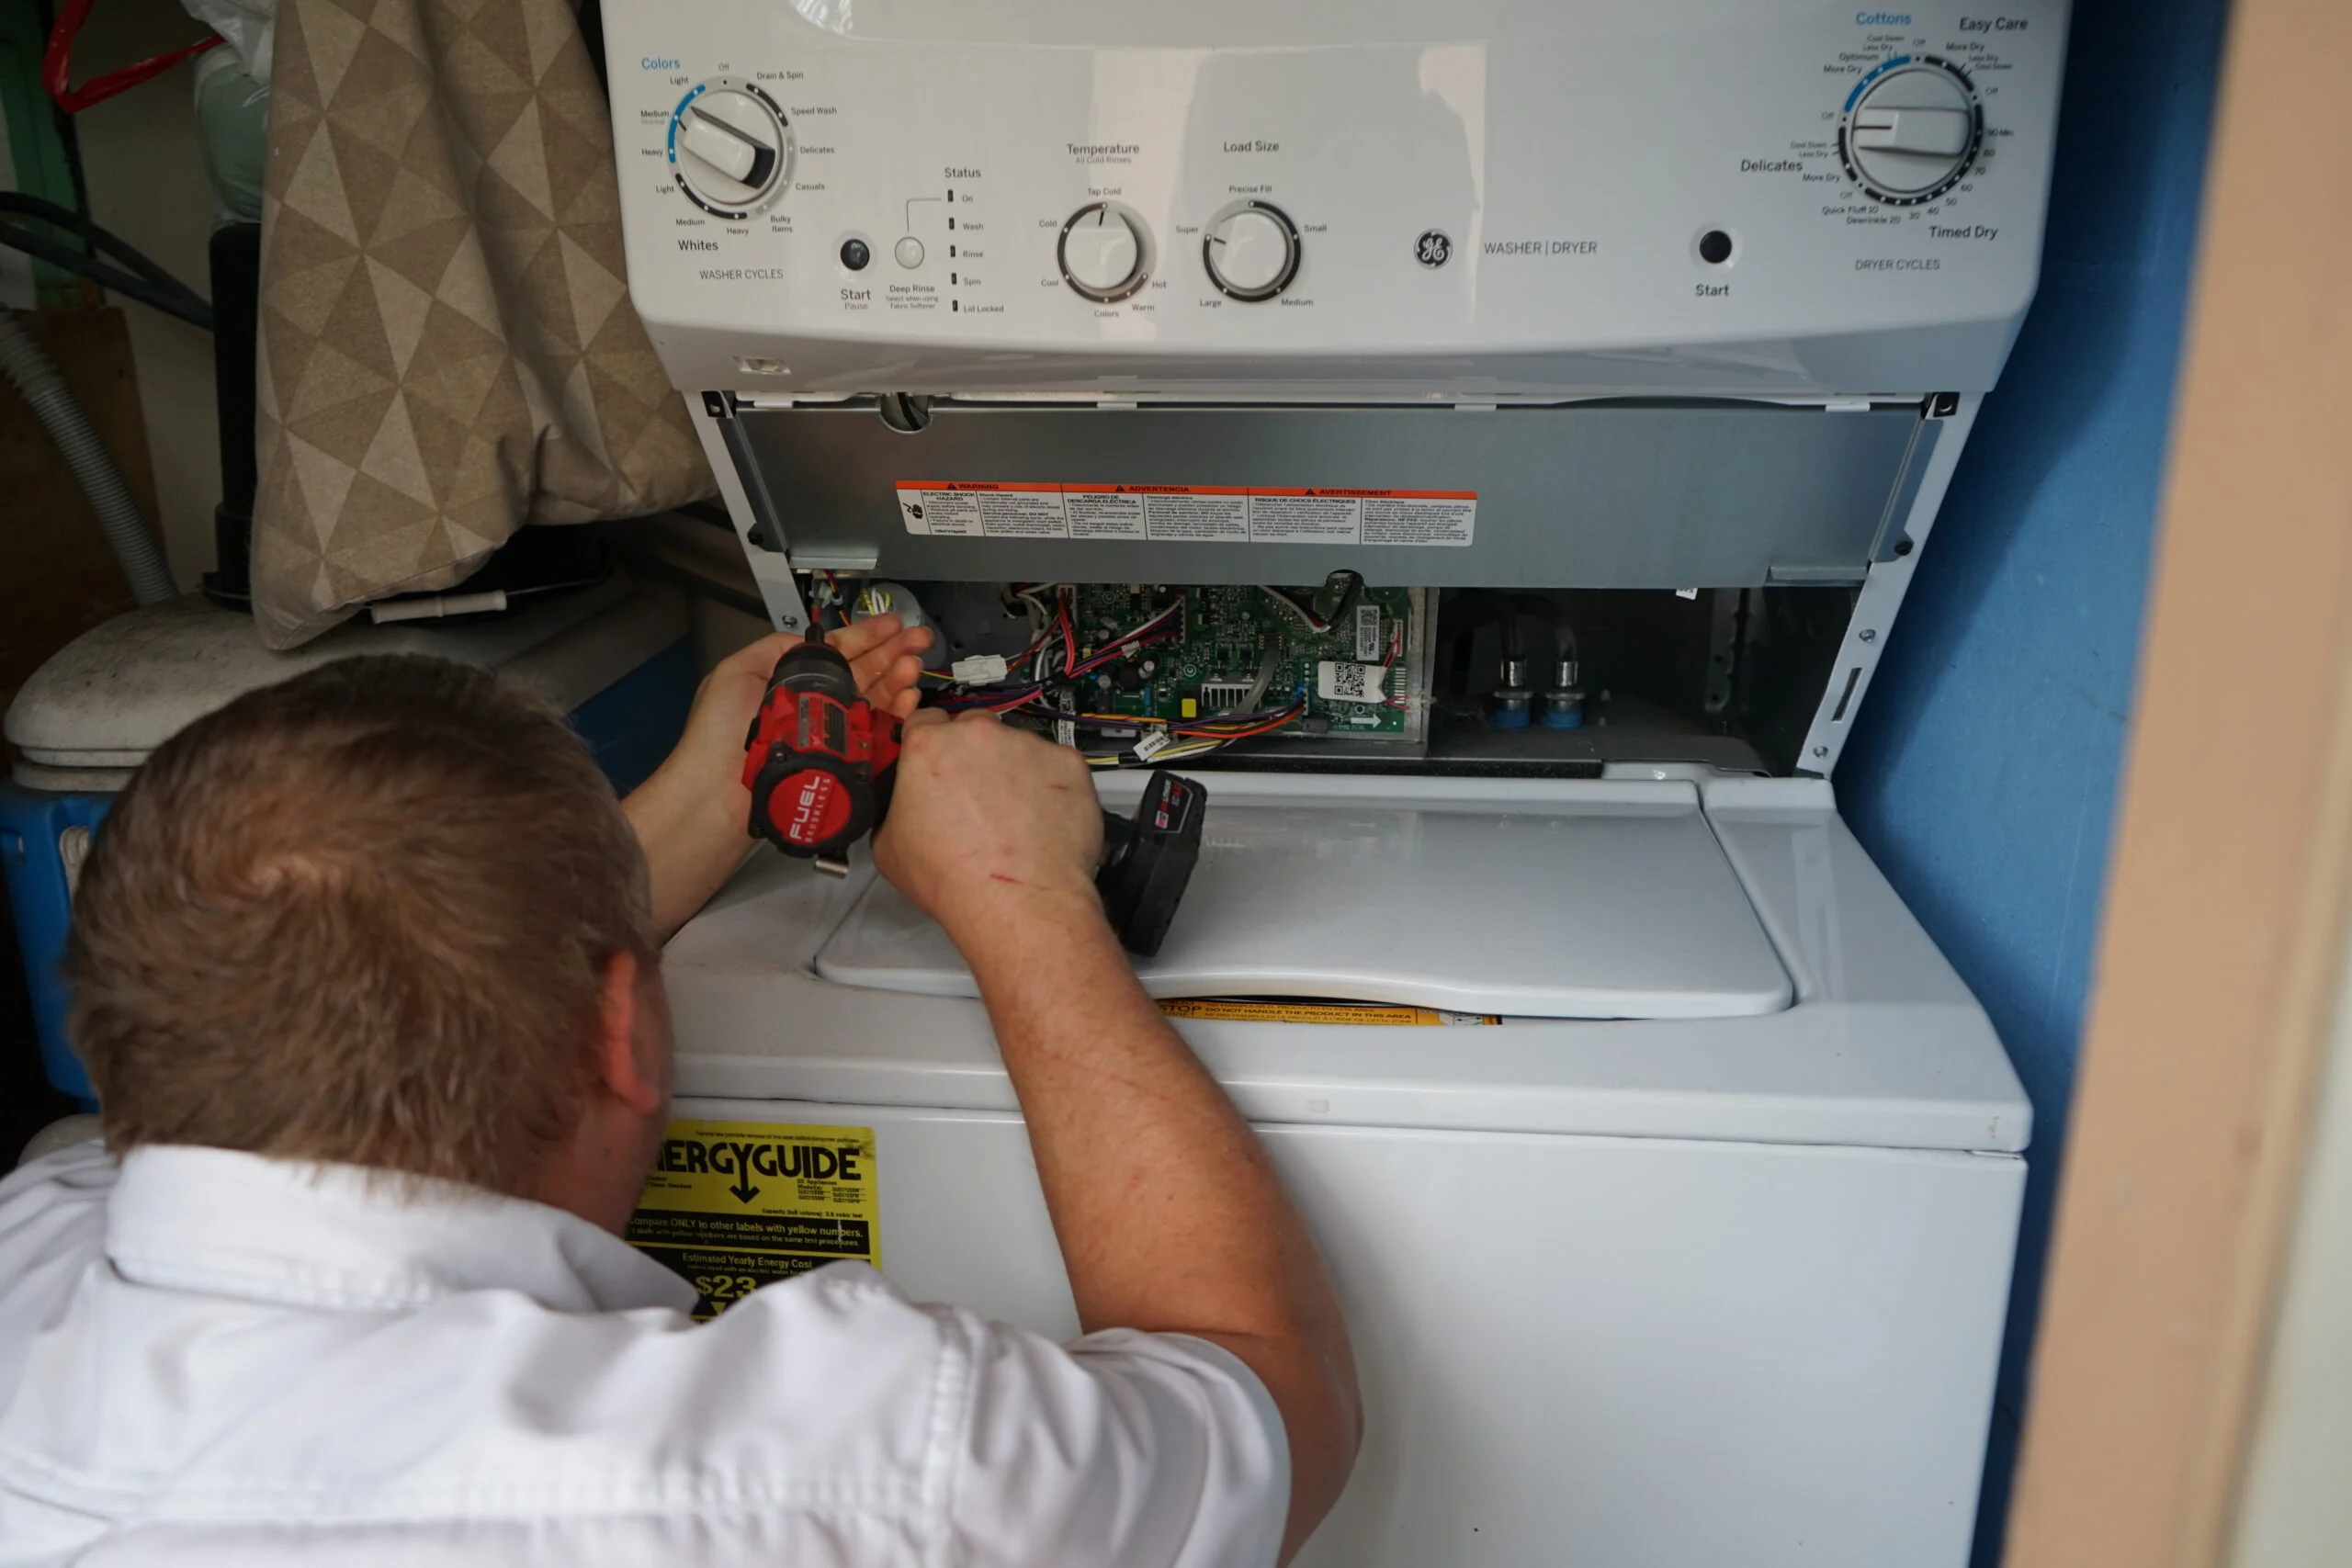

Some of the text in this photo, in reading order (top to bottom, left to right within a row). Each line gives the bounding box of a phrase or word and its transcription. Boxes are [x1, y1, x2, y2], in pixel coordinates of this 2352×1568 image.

[1856, 12, 1912, 26] Cottons
[1960, 17, 2029, 34] Easy Care
[1878, 43, 1893, 52] Dry
[1946, 42, 1984, 52] More Dry
[1839, 52, 1880, 62] Optimum
[1985, 54, 1999, 63] Dry
[641, 57, 681, 70] Colors
[718, 63, 729, 72] Off
[1824, 64, 1862, 75] More Dry
[670, 76, 689, 85] Light
[757, 71, 804, 81] Drain & Spin
[641, 110, 670, 118] Medium
[791, 107, 837, 117] Speed Wash
[1986, 129, 1999, 137] 90
[800, 145, 835, 154] Delicates
[1067, 143, 1140, 156] Temperature
[1224, 141, 1279, 152] Load Size
[641, 149, 663, 158] Heavy
[1816, 151, 1828, 159] Dry
[1983, 148, 1996, 157] 80
[1075, 155, 1132, 164] All Cold Rinses
[1740, 159, 1804, 173] Delicates
[944, 167, 981, 178] Status
[1974, 166, 1986, 176] 70
[1803, 173, 1840, 183] More Dry
[656, 185, 675, 195] Light
[796, 183, 826, 191] Casuals
[1228, 185, 1272, 194] Precise Fill
[1960, 183, 1973, 193] 60
[1088, 187, 1121, 197] Tap Cold
[1839, 190, 1853, 200] Off
[962, 194, 974, 203] On
[1945, 197, 1958, 207] 50
[1822, 205, 1879, 216] Quick Fluff 10
[1927, 207, 1939, 216] 40
[1890, 216, 1901, 224] 20
[1909, 211, 1920, 220] 30
[676, 218, 706, 227] Medium
[770, 216, 791, 225] Bulky
[1039, 220, 1057, 228] Cold
[772, 225, 793, 233] Items
[963, 222, 984, 231] Wash
[1175, 225, 1199, 234] Super
[1304, 223, 1328, 232] Small
[727, 228, 750, 237] Heavy
[1929, 226, 1998, 241] Timed Dry
[678, 240, 718, 252] Whites
[1484, 241, 1598, 255] WASHER DRYER
[963, 250, 984, 258] Rinse
[1855, 259, 1940, 271] DRYER CYCLES
[699, 268, 784, 280] WASHER CYCLES
[964, 277, 981, 287] Spin
[1041, 278, 1058, 287] Cool
[1152, 280, 1167, 289] Hot
[841, 288, 871, 300] Start
[889, 285, 935, 294] Deep Rinse
[1695, 284, 1729, 297] Start
[844, 302, 868, 310] Pause
[1131, 303, 1155, 311] Warm
[1199, 299, 1222, 309] Large
[1281, 298, 1314, 307] Medium
[964, 305, 1004, 313] Lid Locked
[1093, 310, 1119, 319] Colors
[789, 775, 820, 840] FUEL
[656, 1139, 862, 1182] ERGYGUIDE
[671, 1218, 696, 1228] ONLY
[698, 1220, 708, 1229] to
[710, 1221, 734, 1231] other
[736, 1221, 763, 1233] labels
[765, 1224, 786, 1234] with
[787, 1224, 817, 1235] yellow
[683, 1253, 813, 1269] Estimated Yearly Energy Cost
